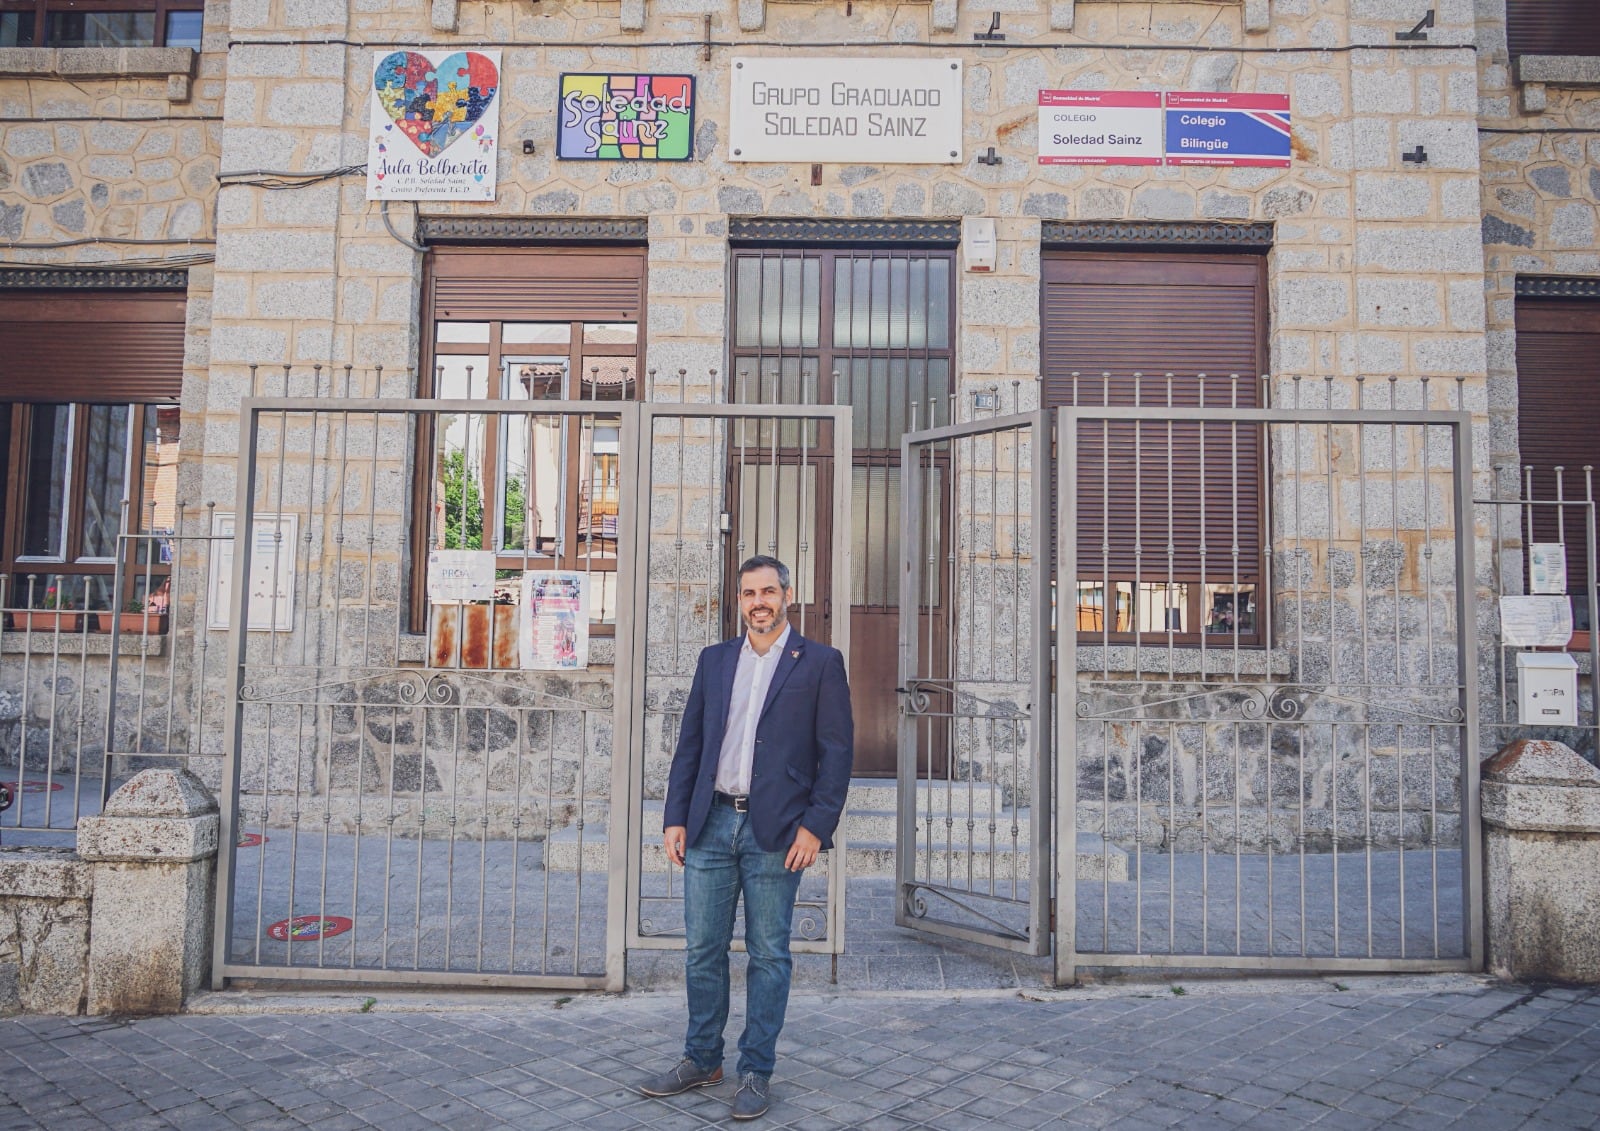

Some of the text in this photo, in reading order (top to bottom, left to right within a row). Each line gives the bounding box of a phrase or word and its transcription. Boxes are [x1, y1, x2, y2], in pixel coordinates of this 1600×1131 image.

[752, 81, 941, 107] GRUPO GRADUADO
[564, 82, 689, 128] Soledad
[765, 112, 927, 137] SOLEDAD SAINZ
[1053, 114, 1097, 122] COLEGIO
[1180, 114, 1227, 128] Colegio
[583, 115, 669, 153] Sainz
[1053, 133, 1143, 145] Soledad Sainz
[1180, 137, 1229, 151] Bilingüe
[376, 158, 489, 176] Aula Bolboreta
